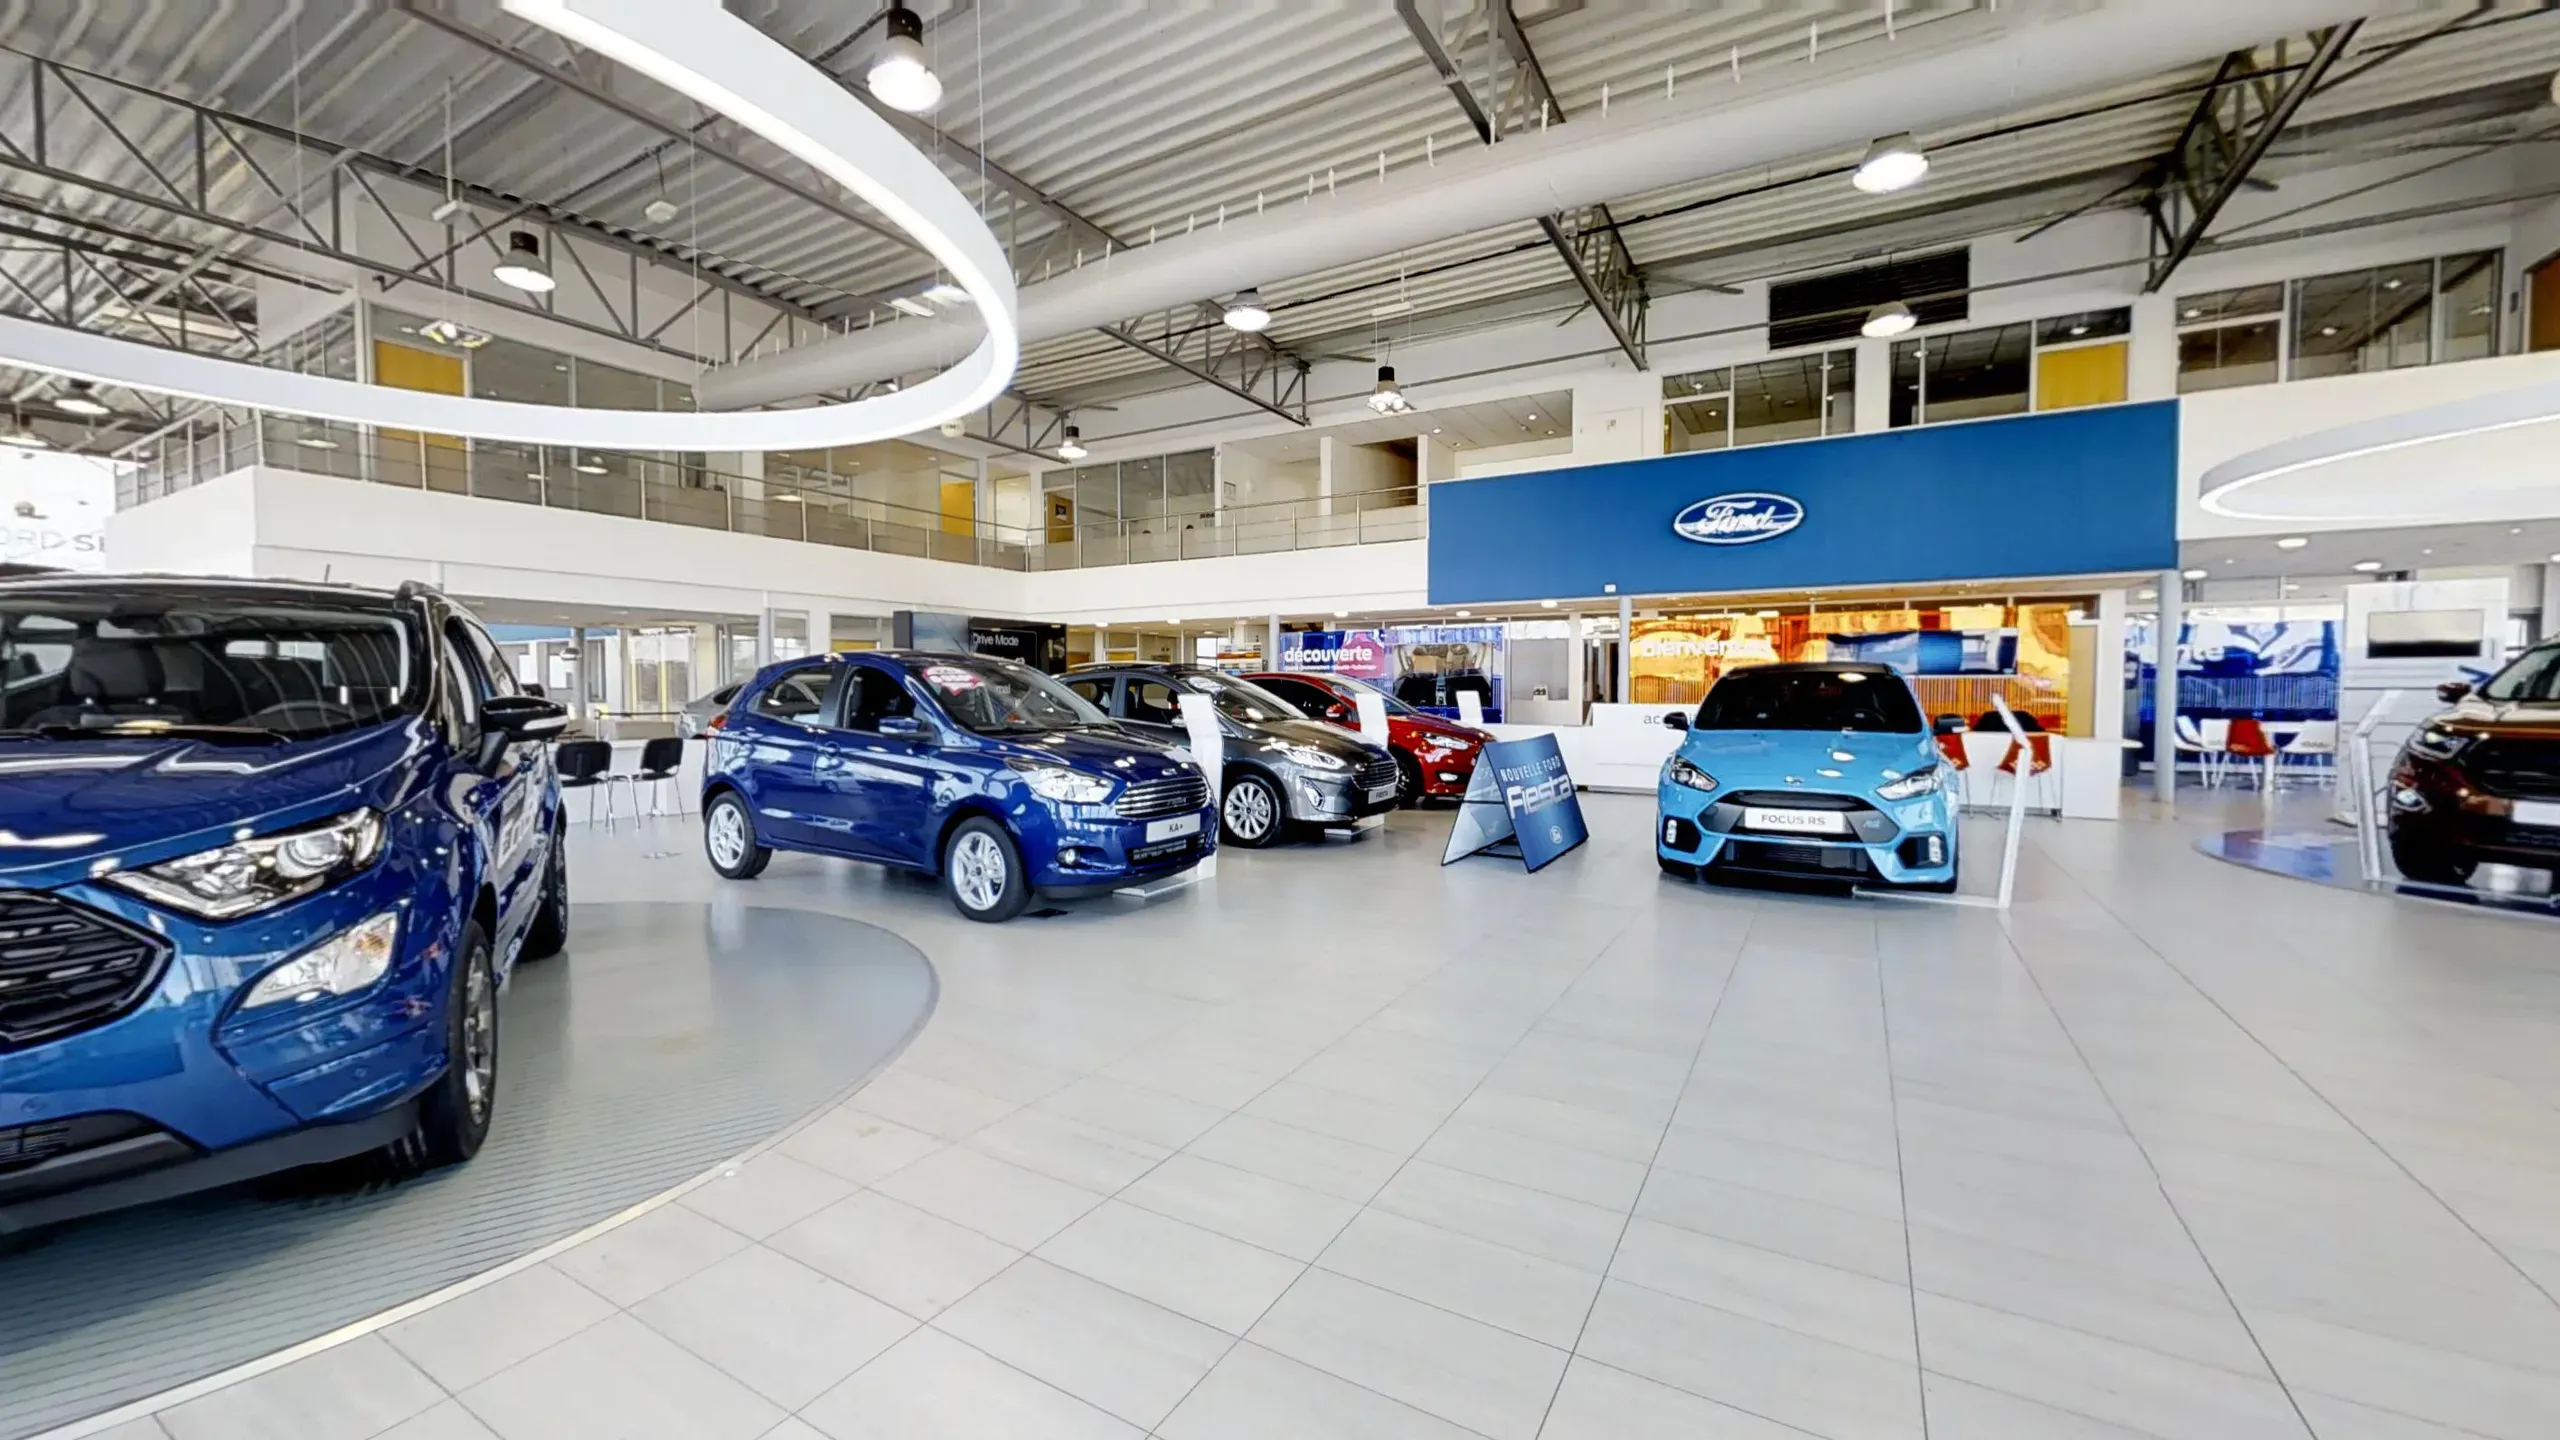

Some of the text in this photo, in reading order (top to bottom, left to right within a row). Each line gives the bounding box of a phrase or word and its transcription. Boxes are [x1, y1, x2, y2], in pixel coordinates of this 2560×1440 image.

[972, 633, 1019, 647] Drive Mode
[1284, 646, 1373, 662] découverte
[1500, 755, 1561, 782] NOUVELLE FORD
[1507, 774, 1572, 820] Fiesta
[1761, 814, 1825, 826] FOCUS RS
